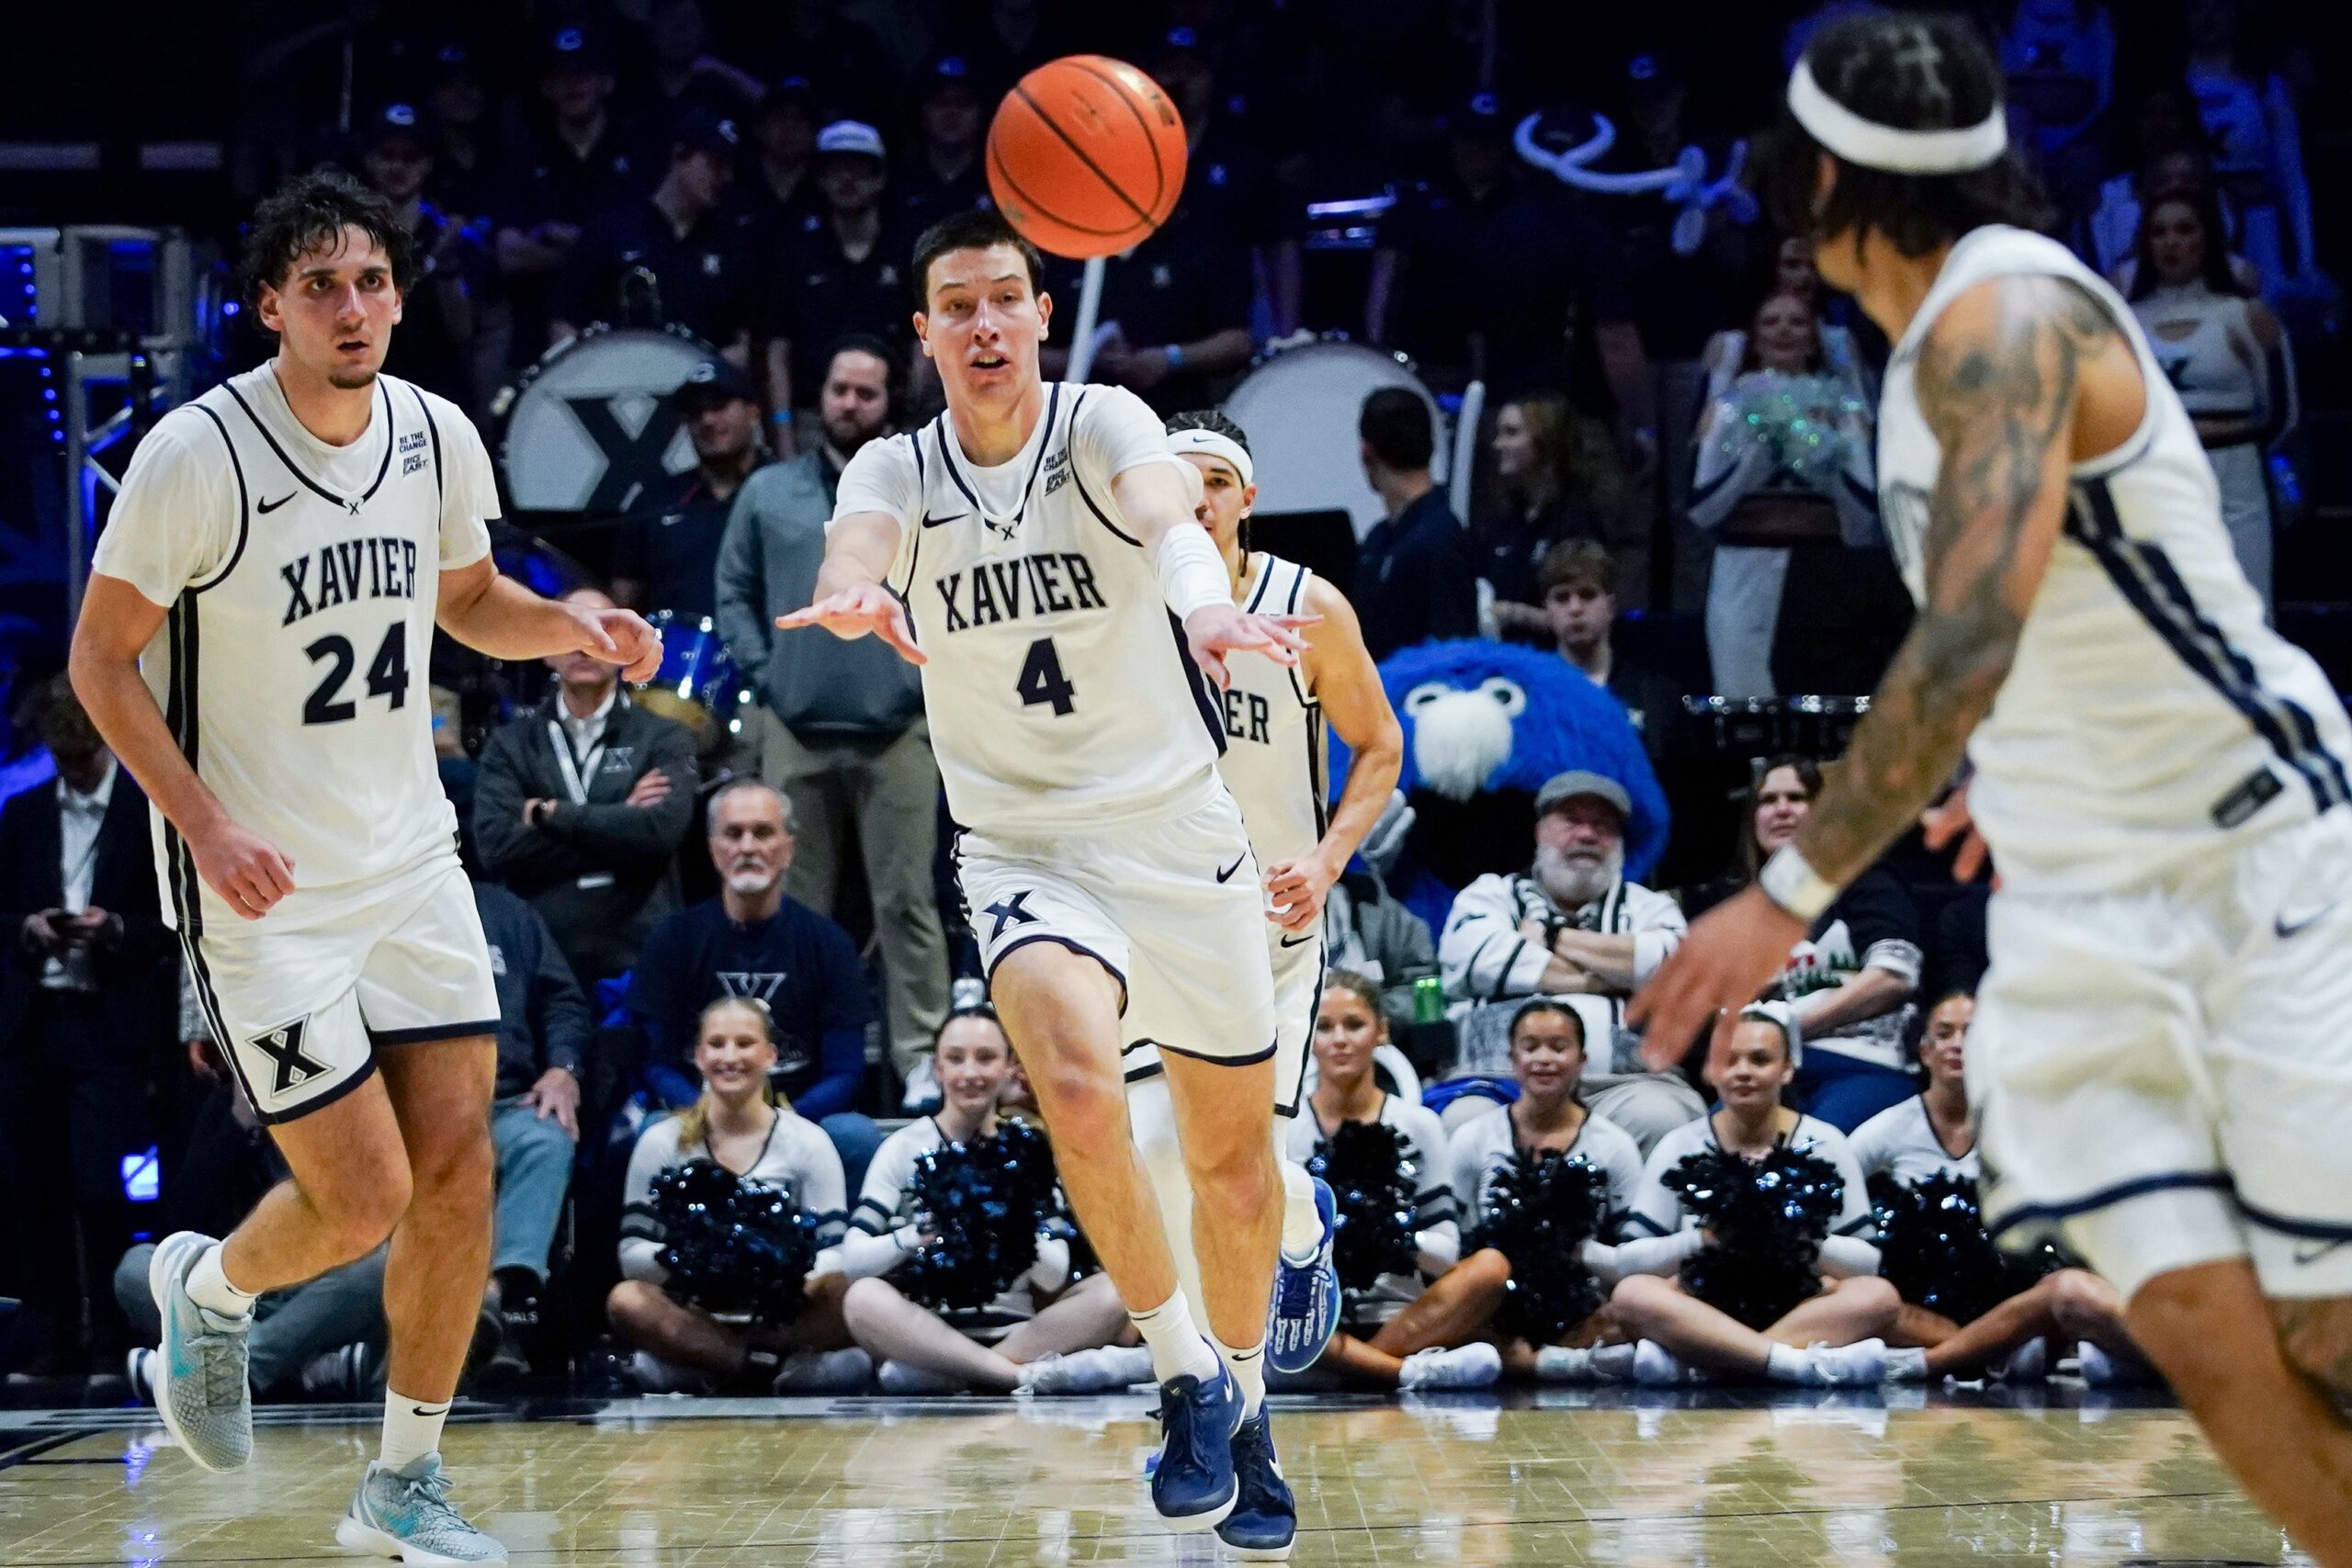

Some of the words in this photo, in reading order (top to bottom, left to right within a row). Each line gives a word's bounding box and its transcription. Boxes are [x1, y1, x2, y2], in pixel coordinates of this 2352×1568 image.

[399, 439, 427, 454] CHANGE
[400, 435, 408, 445] BE
[410, 431, 424, 443] THE
[349, 502, 359, 516] X
[1001, 525, 1014, 541] X
[280, 536, 416, 628] XAVIER
[936, 552, 1108, 633] XAVIER
[301, 619, 409, 727] 24
[1014, 635, 1078, 718] 4
[977, 887, 1050, 955] X
[244, 1011, 336, 1099] X
